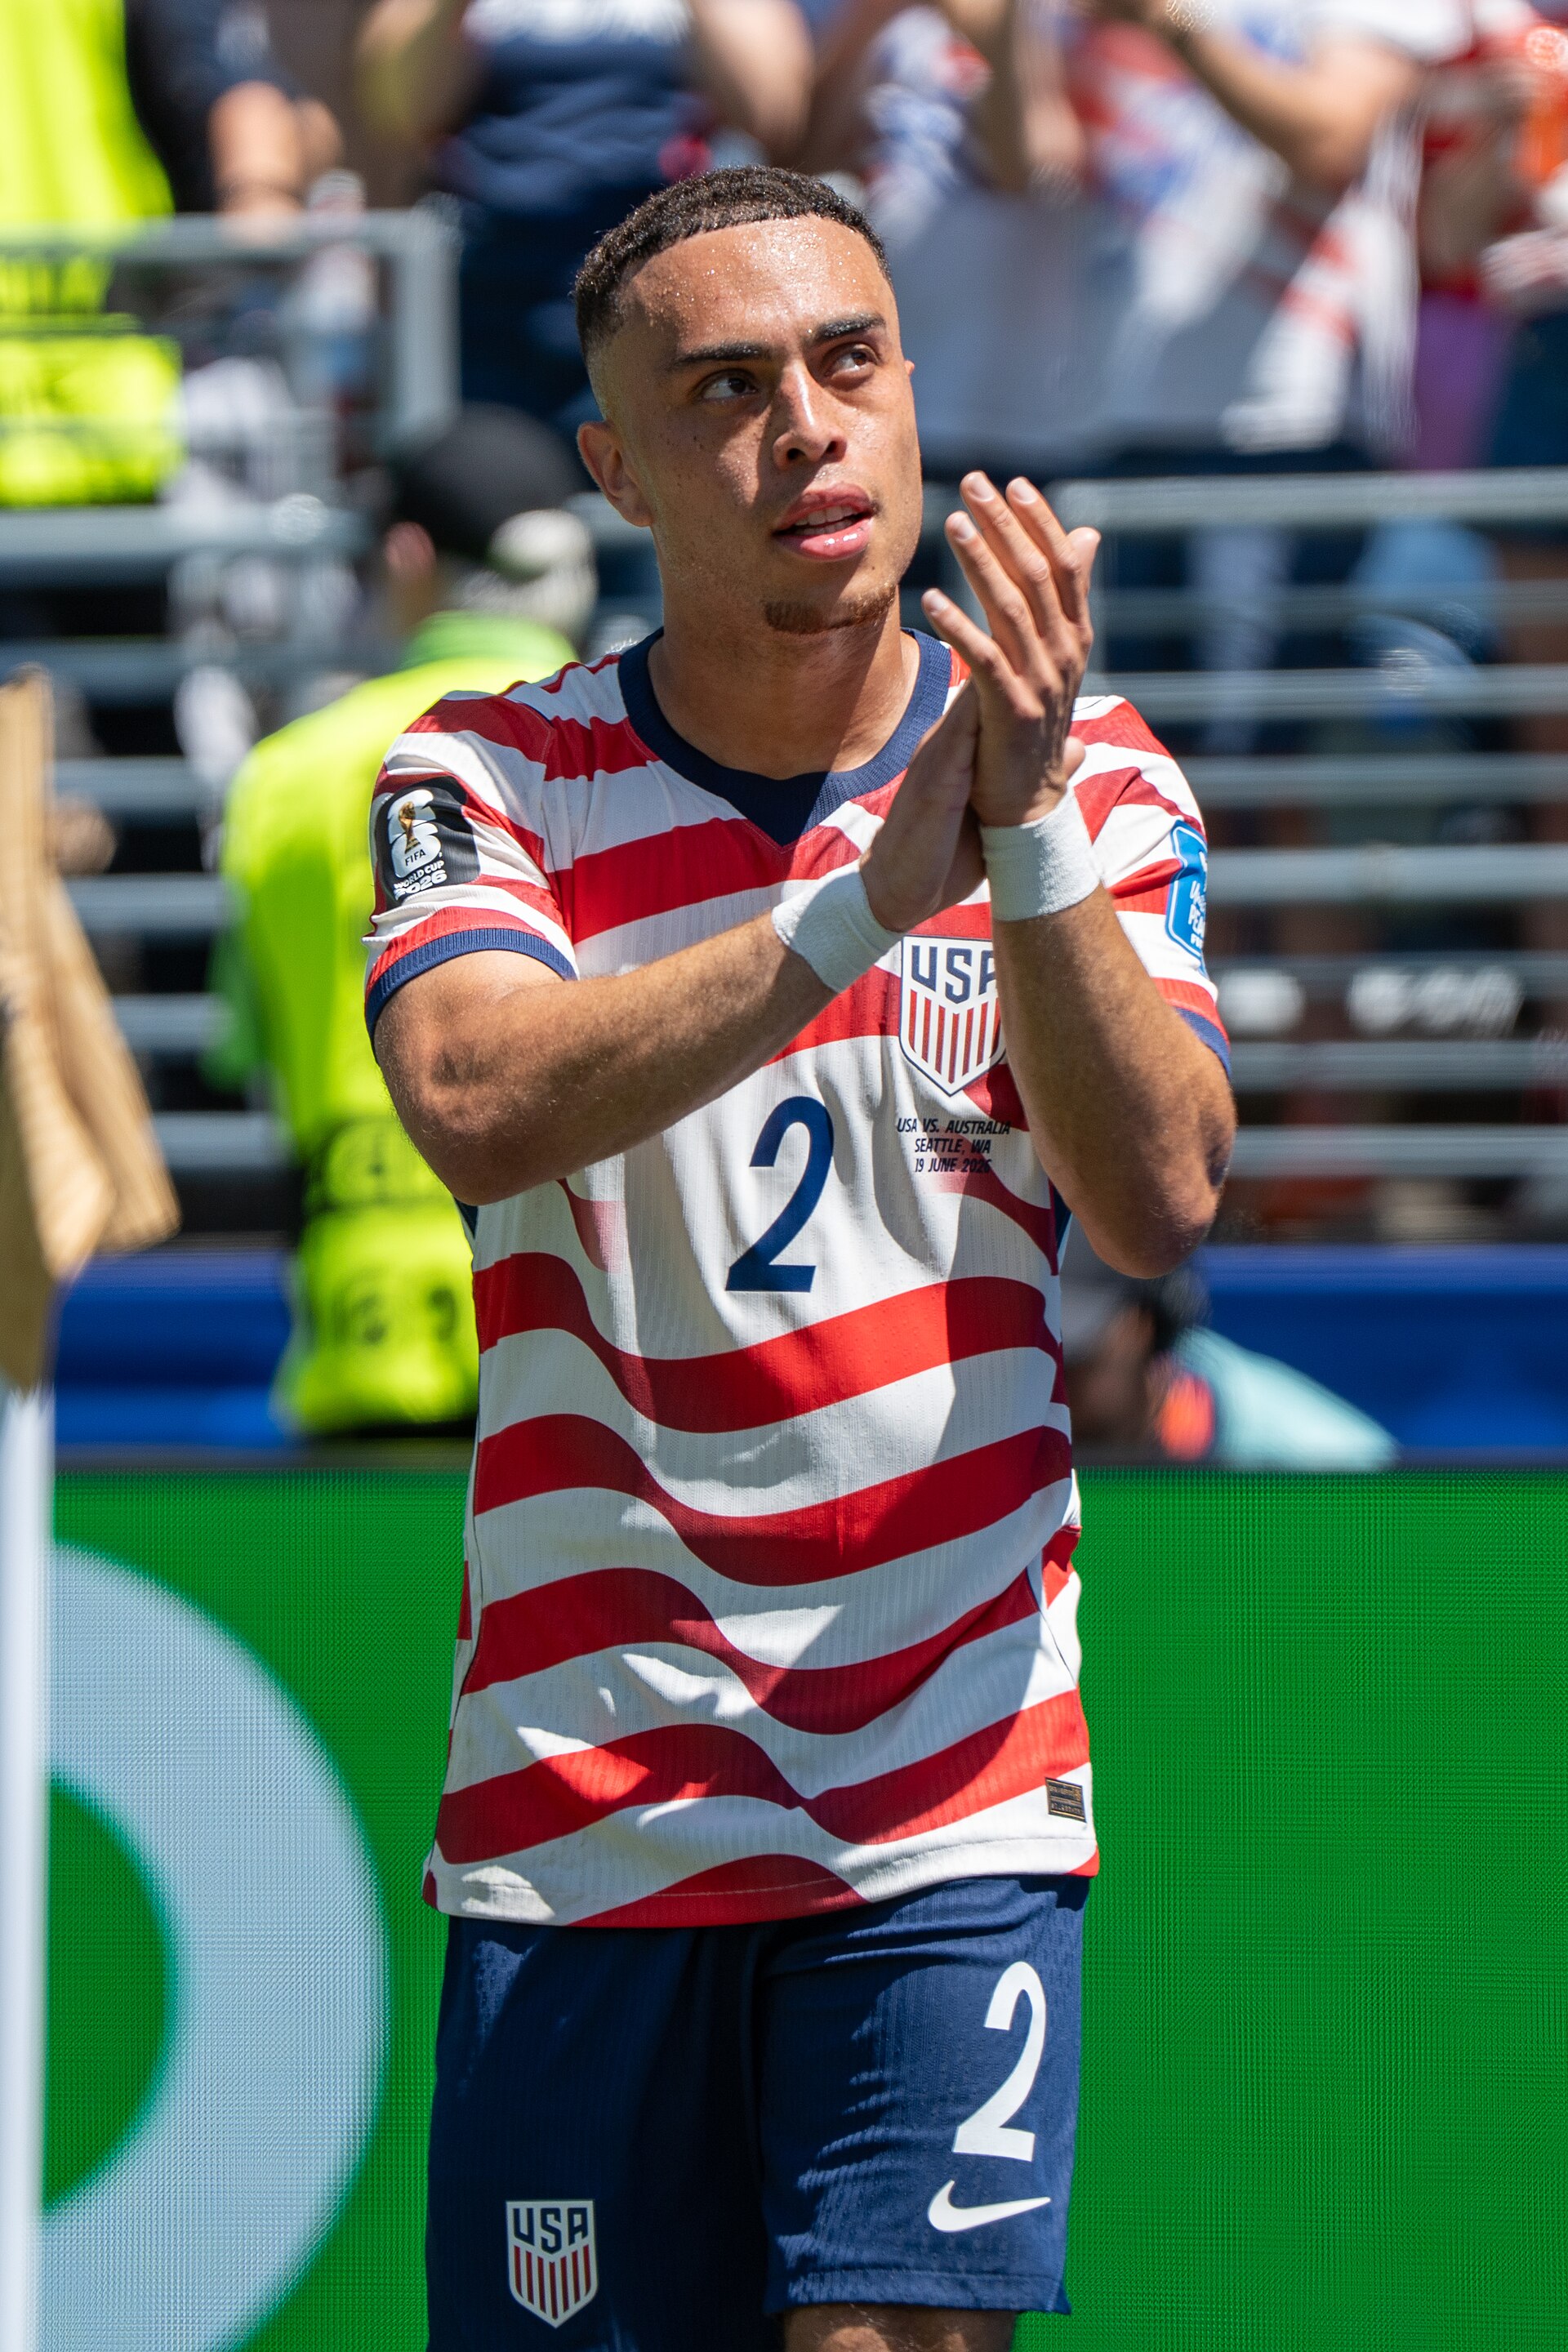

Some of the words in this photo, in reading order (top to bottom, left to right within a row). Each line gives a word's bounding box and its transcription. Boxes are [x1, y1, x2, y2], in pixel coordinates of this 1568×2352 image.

[405, 849, 426, 866] FIFA
[394, 869, 425, 889] WORLD
[425, 860, 444, 874] CUP
[394, 869, 448, 901] 2026
[897, 1118, 917, 1133] USA
[922, 1118, 940, 1133] VS.
[945, 1120, 1011, 1134] AUSTRALIA
[915, 1138, 964, 1155] SEATTLE,
[971, 1139, 991, 1153] WA
[915, 1158, 924, 1172] 19
[928, 1158, 958, 1172] JUNE
[960, 1159, 992, 1173] 2026
[725, 1096, 835, 1293] 2
[952, 1961, 1047, 2162] 2
[513, 2207, 589, 2255] USA
